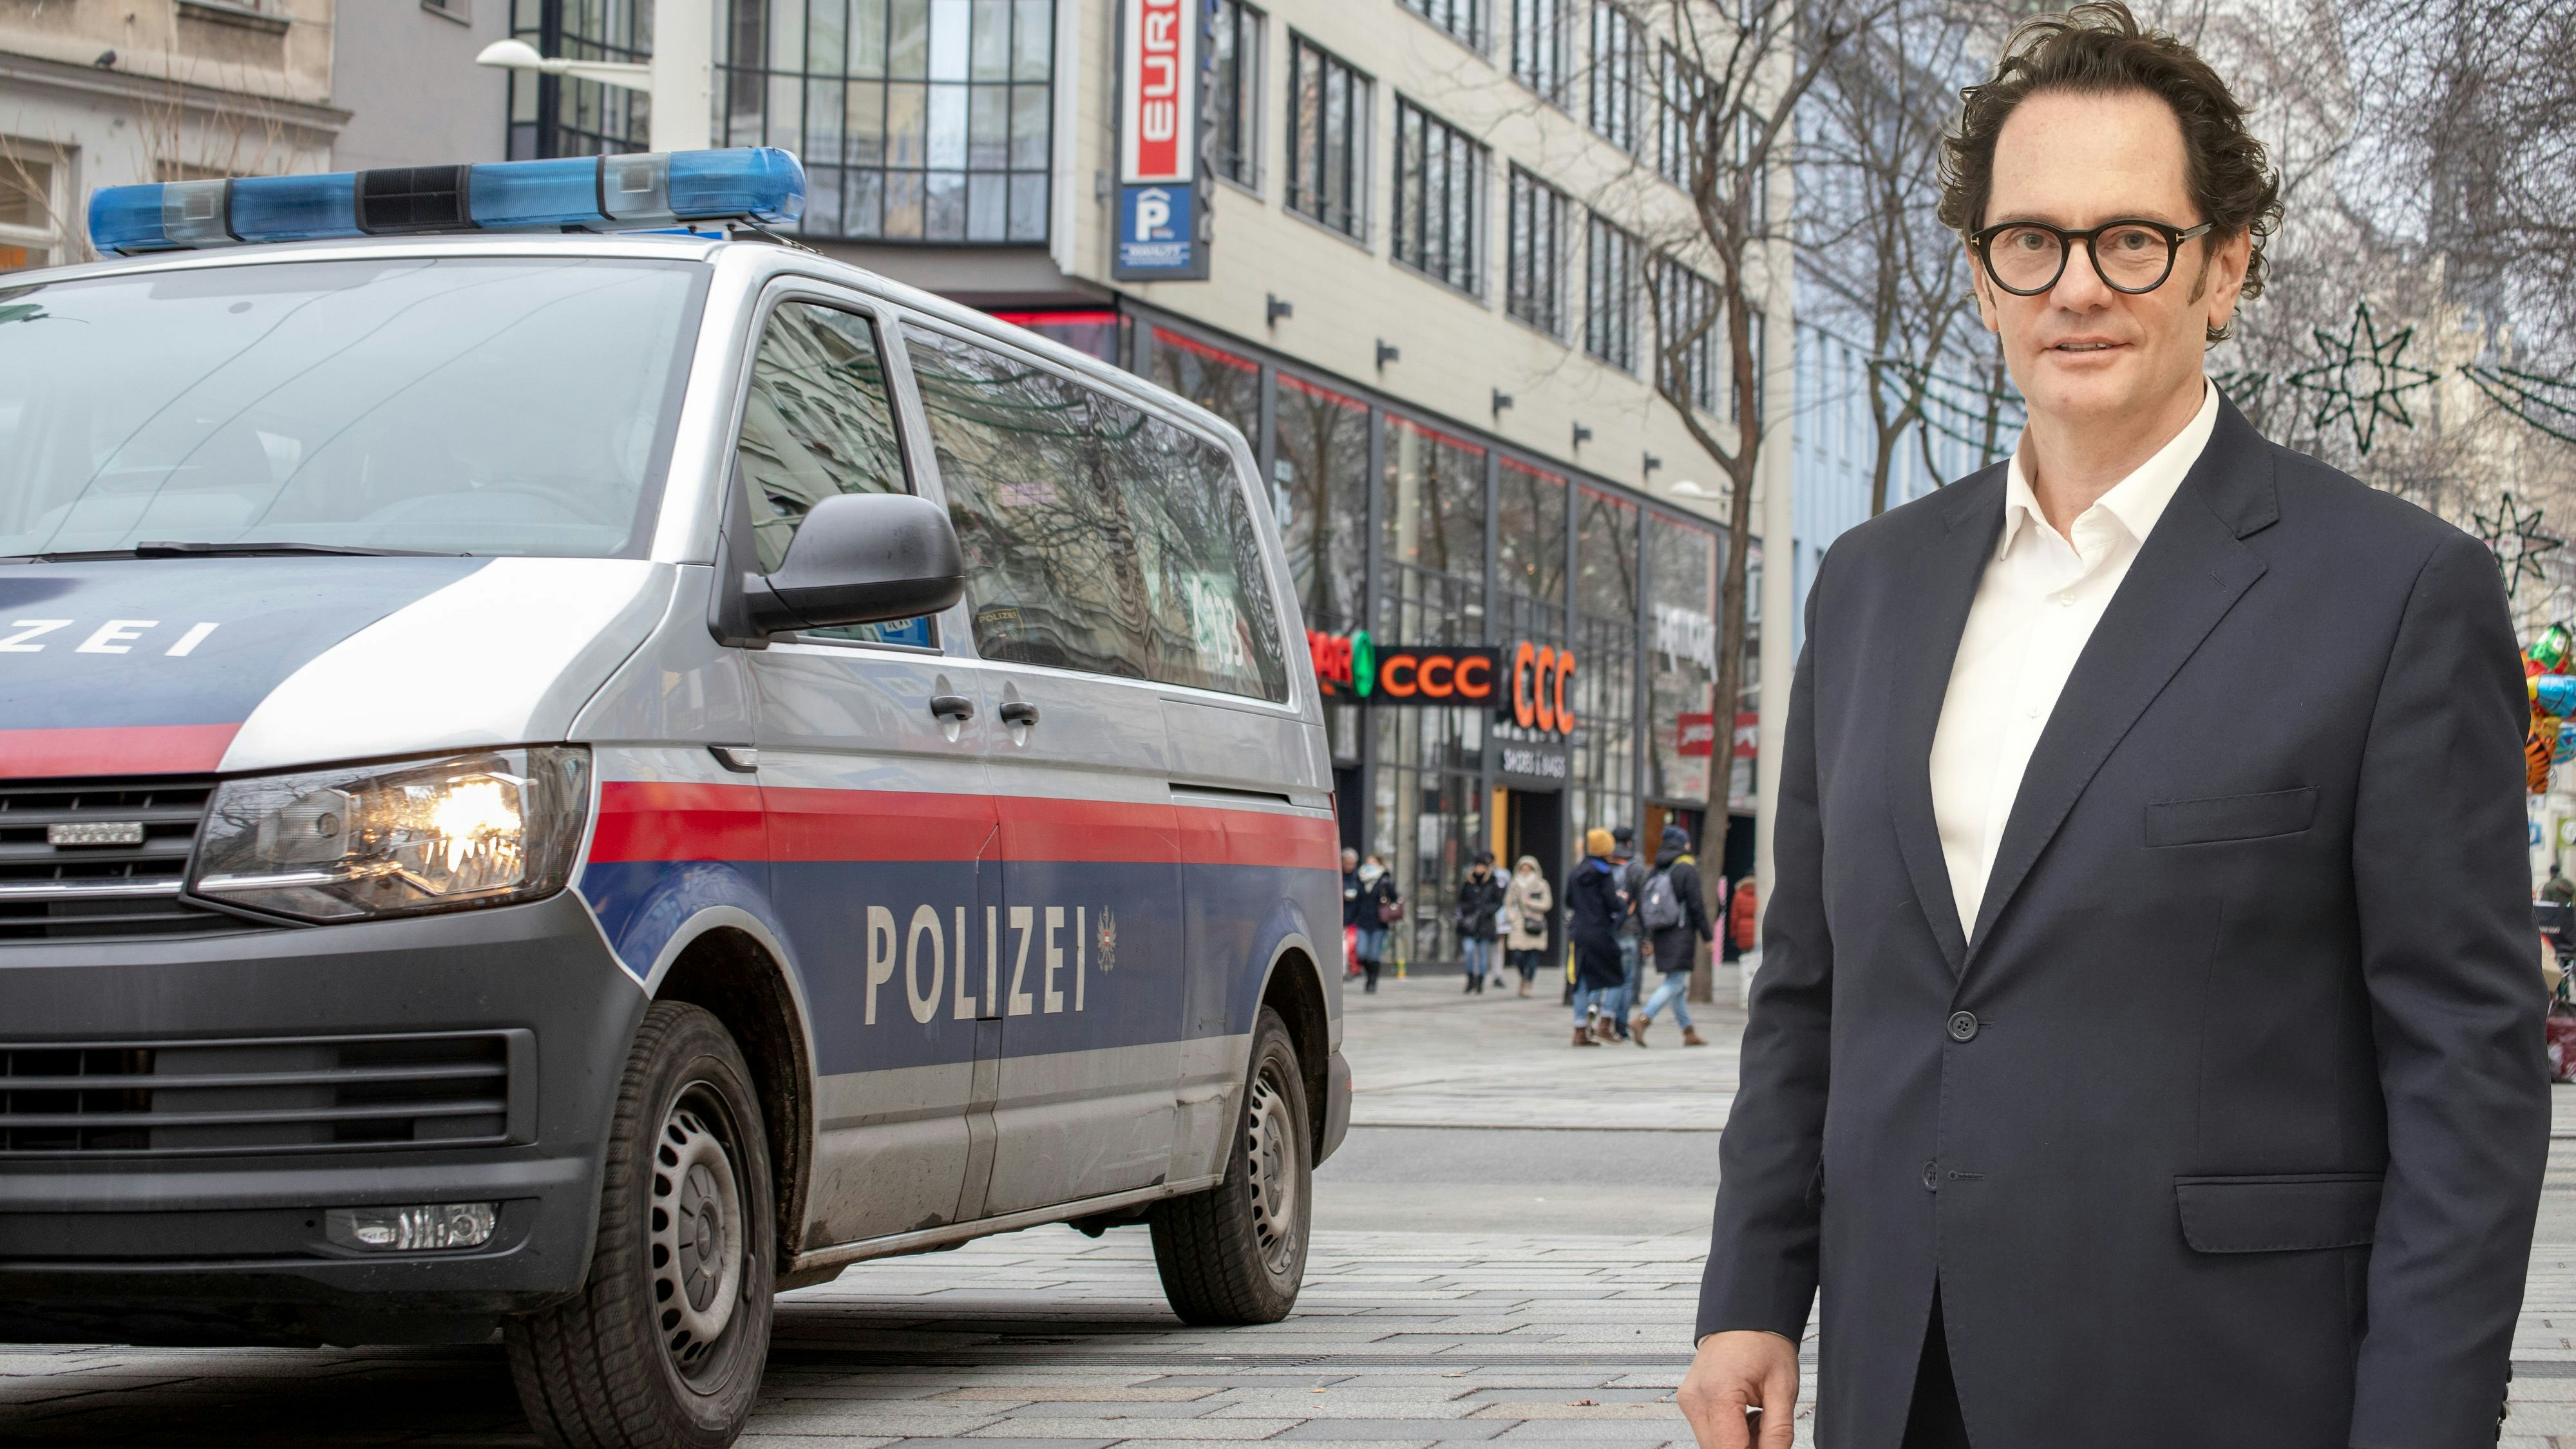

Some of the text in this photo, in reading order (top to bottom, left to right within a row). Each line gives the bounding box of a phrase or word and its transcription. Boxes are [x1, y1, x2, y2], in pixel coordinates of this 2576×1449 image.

[1142, 0, 1177, 142] EUR
[1135, 200, 1170, 242] P
[978, 611, 1018, 624] POLIZEI
[1205, 594, 1244, 667] 133
[1380, 654, 1492, 698] CCC
[1513, 640, 1576, 735] CCC
[865, 904, 1085, 1025] POLIZEI
